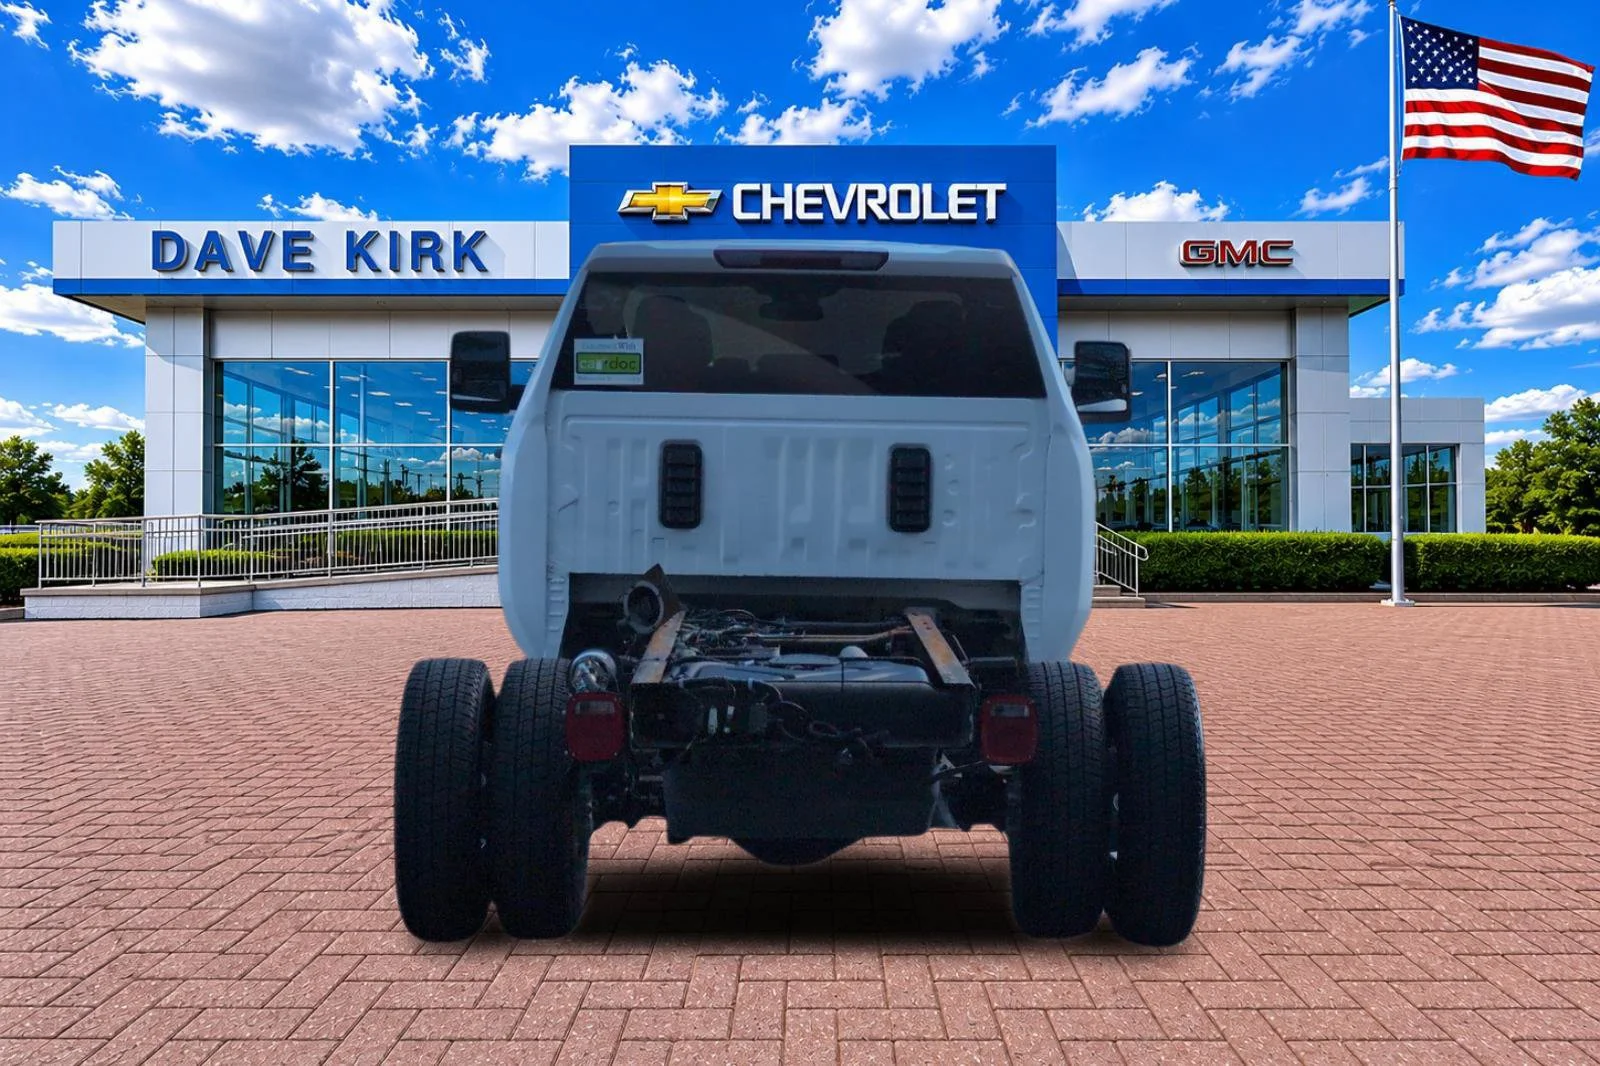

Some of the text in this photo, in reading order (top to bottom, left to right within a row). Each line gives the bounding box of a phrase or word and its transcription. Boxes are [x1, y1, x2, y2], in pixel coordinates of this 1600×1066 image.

[732, 183, 1007, 222] CHEVROLET
[151, 230, 488, 272] DAVE KIRK
[1179, 240, 1293, 267] GMC
